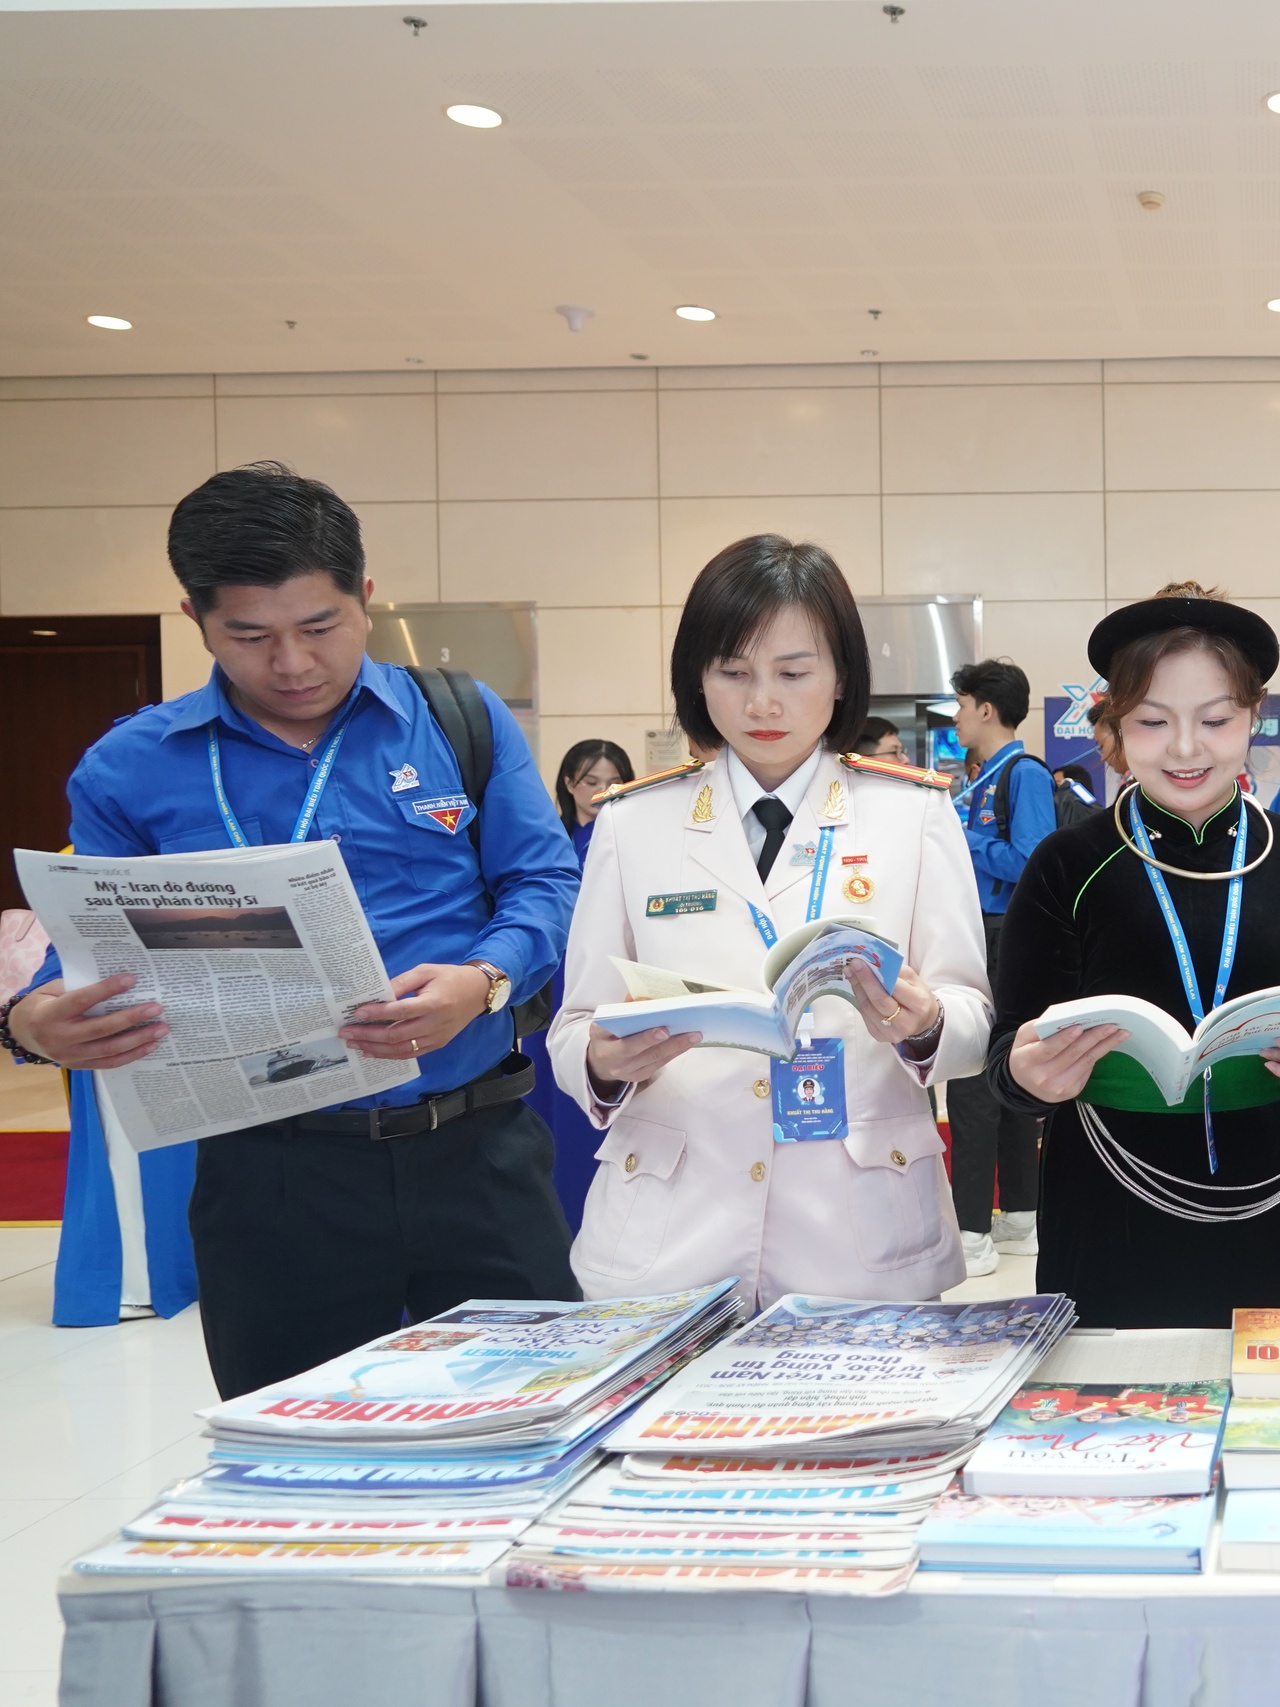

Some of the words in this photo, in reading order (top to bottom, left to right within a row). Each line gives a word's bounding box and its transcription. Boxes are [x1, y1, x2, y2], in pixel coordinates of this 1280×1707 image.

[441, 648, 450, 663] 3
[296, 828, 305, 839] ĐẠI
[313, 777, 323, 794] TOÀN
[94, 881, 118, 894] Mỹ
[128, 881, 160, 892] Iran
[164, 882, 183, 893] dò
[186, 881, 236, 894] đường
[85, 896, 112, 906] sau
[116, 895, 150, 906] đàm
[155, 895, 191, 908] phán
[194, 895, 204, 906] ở
[205, 895, 241, 908] Thụy
[759, 918, 768, 929] HỘI
[764, 929, 773, 940] ĐẠI
[505, 1349, 578, 1358] THANH
[775, 1350, 842, 1362] Đảng
[845, 1354, 903, 1364] theo
[731, 1360, 767, 1370] tin
[770, 1360, 834, 1372] vững
[842, 1363, 897, 1375] hào,
[710, 1370, 772, 1380] Nam
[772, 1372, 824, 1381] Việt
[257, 1397, 393, 1422] NIÊN
[383, 1387, 567, 1422] THANH
[639, 1415, 762, 1441] NIÊN
[1008, 1450, 1067, 1460] yêu
[1083, 1450, 1136, 1463] Tôi
